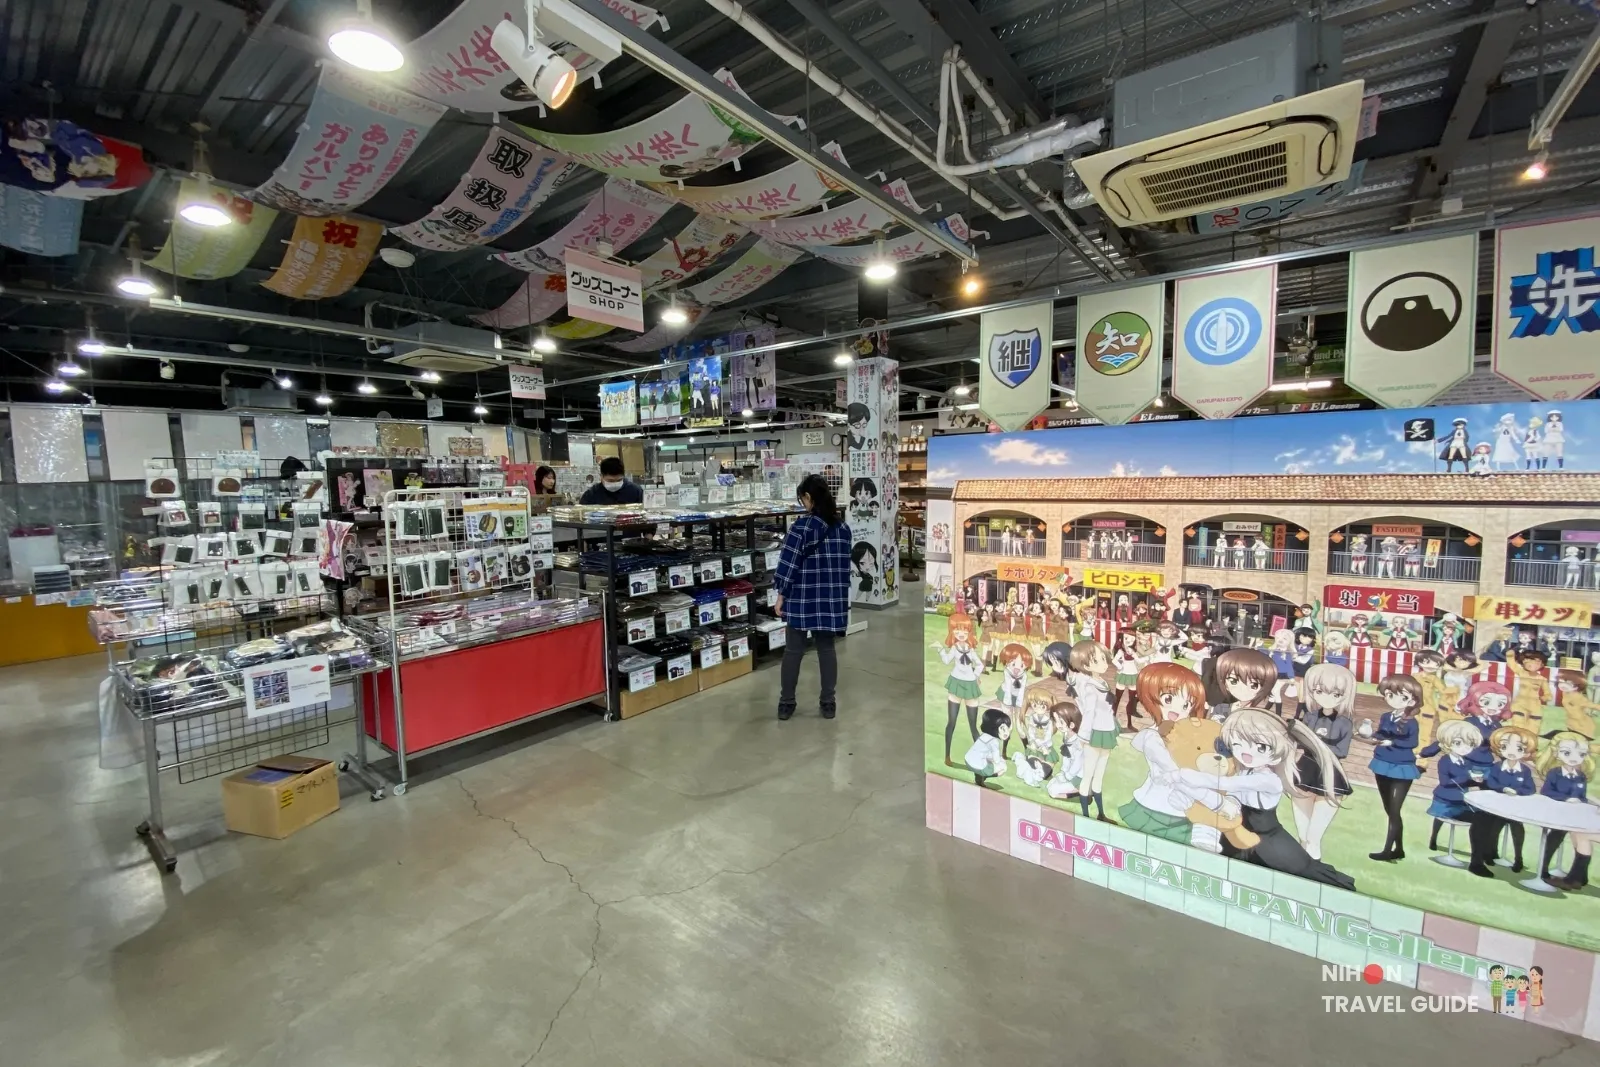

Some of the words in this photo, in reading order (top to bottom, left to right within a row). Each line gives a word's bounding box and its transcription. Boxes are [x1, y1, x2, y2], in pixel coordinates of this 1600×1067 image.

[442, 137, 532, 232] 取扱店
[322, 220, 360, 249] 祝
[571, 270, 639, 298] グッズコーナー
[588, 295, 625, 311] SHOP
[1096, 321, 1140, 354] 知
[1375, 526, 1415, 534] FASTFOOD
[1091, 572, 1153, 589] ピロシキ
[1340, 590, 1361, 606] 射
[1397, 594, 1419, 612] 当
[1495, 602, 1575, 622] 串カツ
[1018, 818, 1125, 871] OARAI
[1125, 850, 1335, 936] GARUPAN
